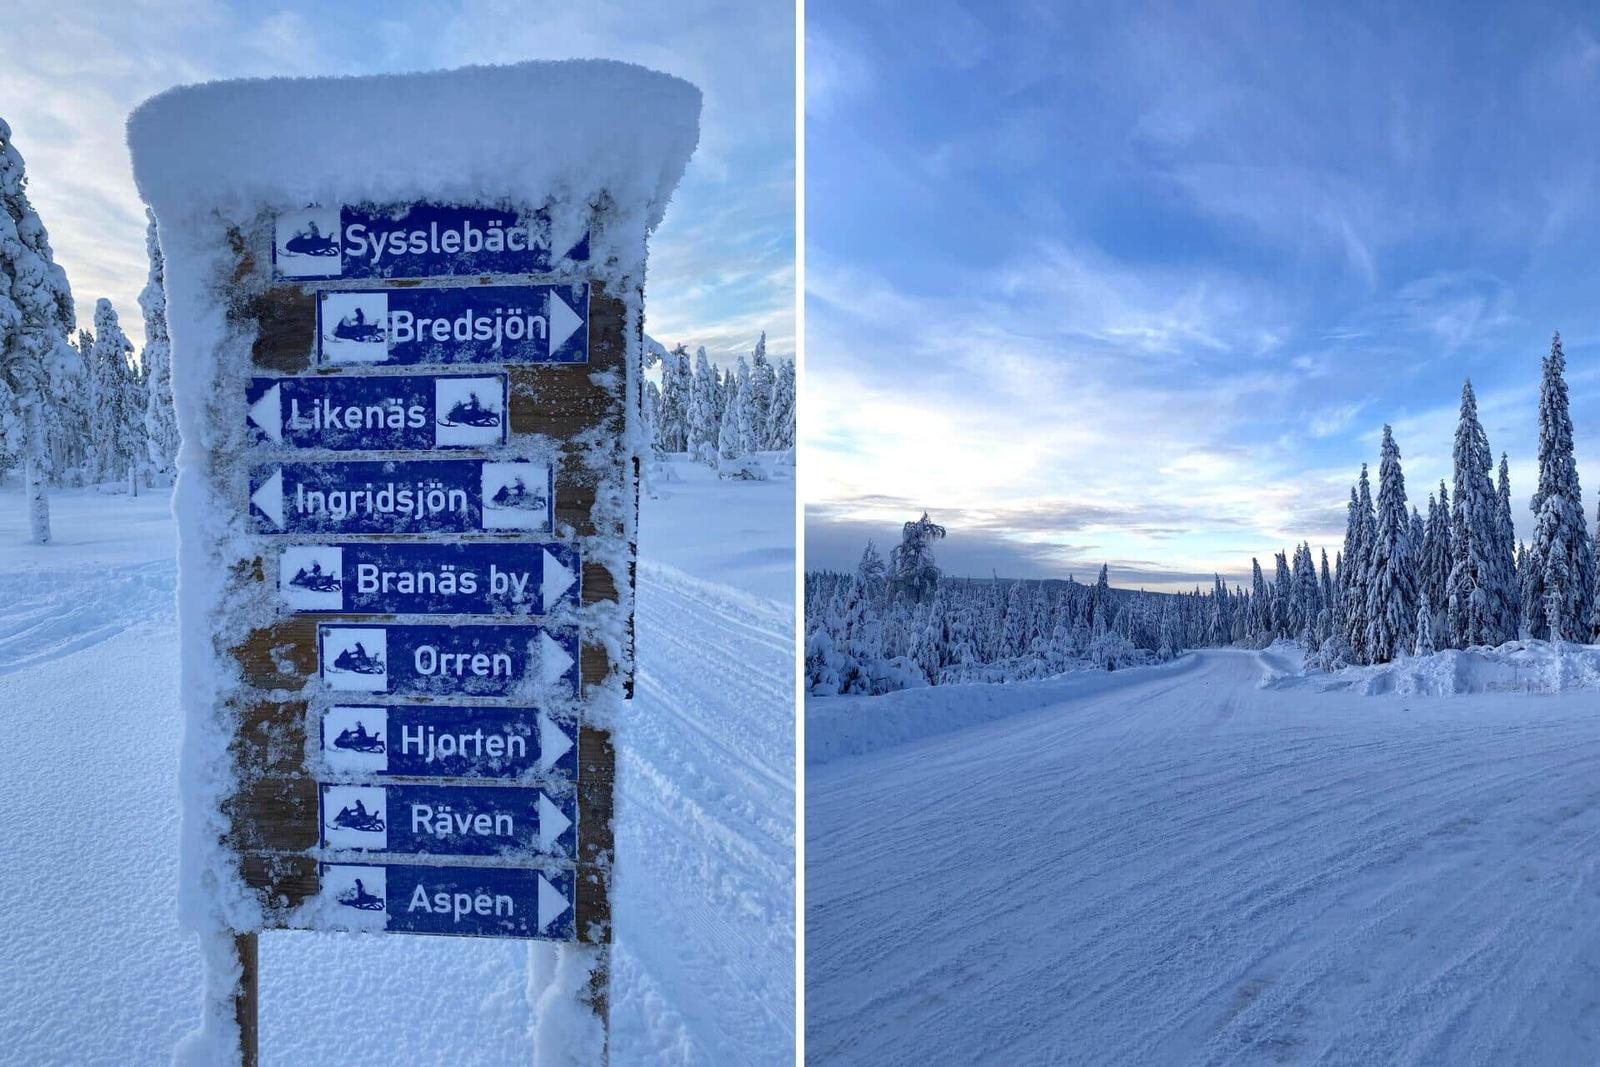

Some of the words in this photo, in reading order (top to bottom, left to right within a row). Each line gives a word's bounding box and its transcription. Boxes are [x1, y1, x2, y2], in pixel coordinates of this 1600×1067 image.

[344, 220, 550, 263] Sysslebäck
[391, 308, 547, 346] Bredsjön
[290, 398, 427, 430] Likenäs
[296, 483, 468, 521] Ingridsjön
[357, 563, 478, 594] Branäs
[490, 563, 529, 600] by
[414, 645, 512, 677] Orren
[401, 725, 526, 763] Hjorten
[411, 804, 514, 836] Räven
[407, 884, 514, 923] Aspen
